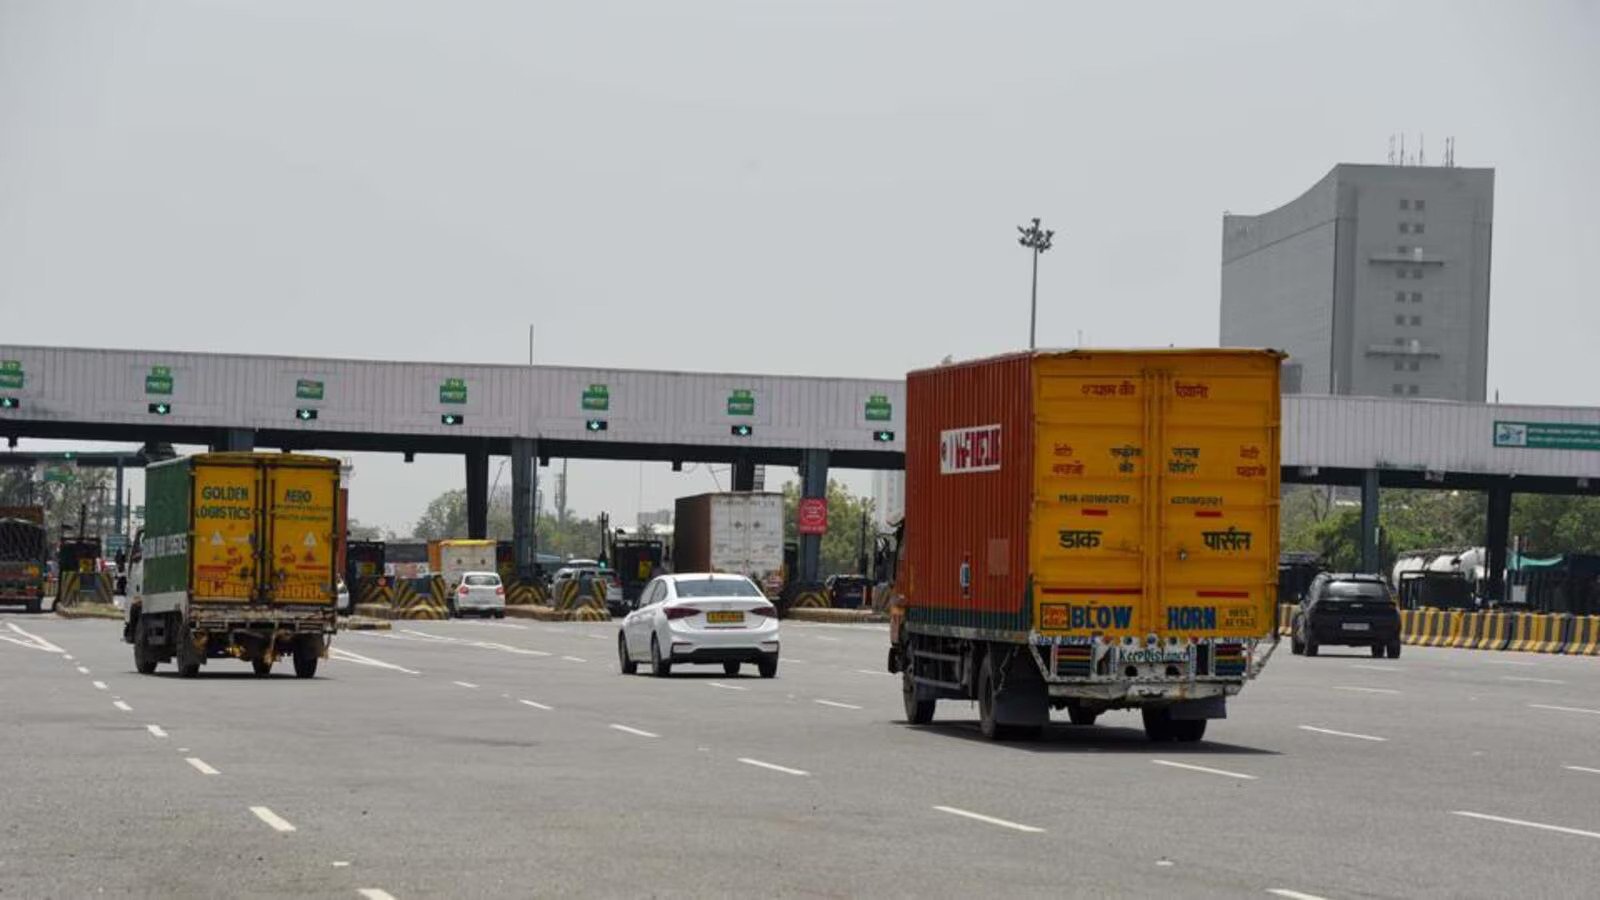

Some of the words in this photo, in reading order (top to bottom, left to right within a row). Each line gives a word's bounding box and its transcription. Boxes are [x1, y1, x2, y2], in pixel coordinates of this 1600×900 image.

[202, 486, 249, 500] GOLDEN
[285, 488, 312, 503] AERO
[195, 505, 250, 520] LOGISTICS
[1058, 529, 1103, 549] डाक
[1202, 526, 1252, 550] पार्सल
[1071, 605, 1133, 629] BLOW
[1168, 606, 1217, 630] HORN
